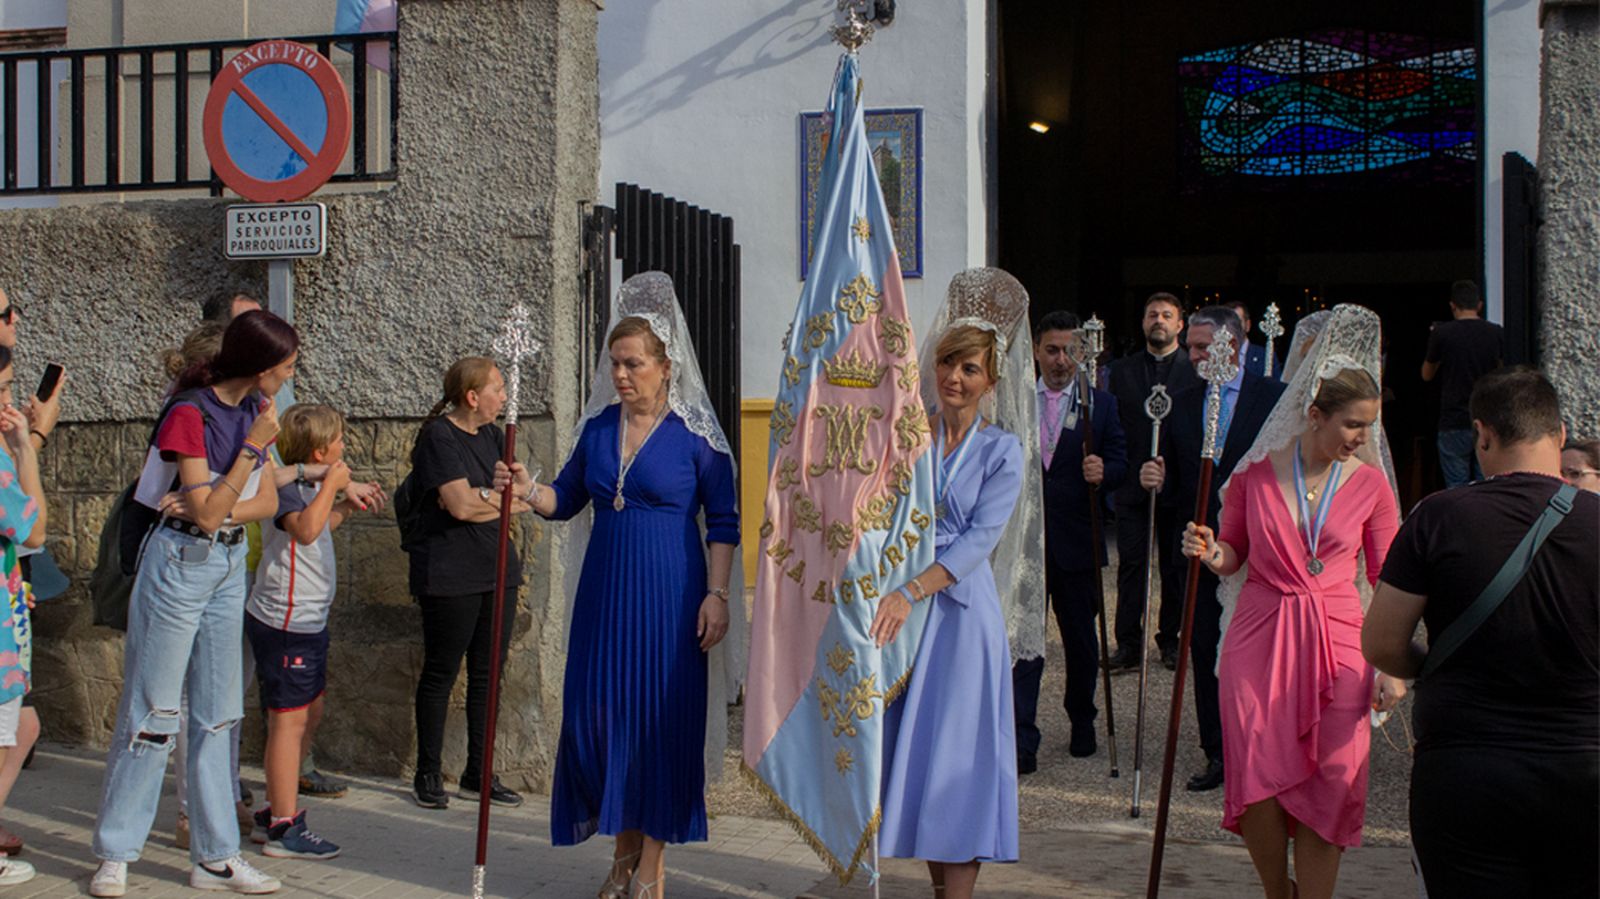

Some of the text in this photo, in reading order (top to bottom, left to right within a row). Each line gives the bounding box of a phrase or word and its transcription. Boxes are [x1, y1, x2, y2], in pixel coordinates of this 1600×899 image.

[231, 42, 319, 73] EXCEPTO
[236, 210, 312, 223] EXCEPTO
[235, 224, 313, 238] SERVICIOS
[230, 237, 316, 252] PARROQUIALES
